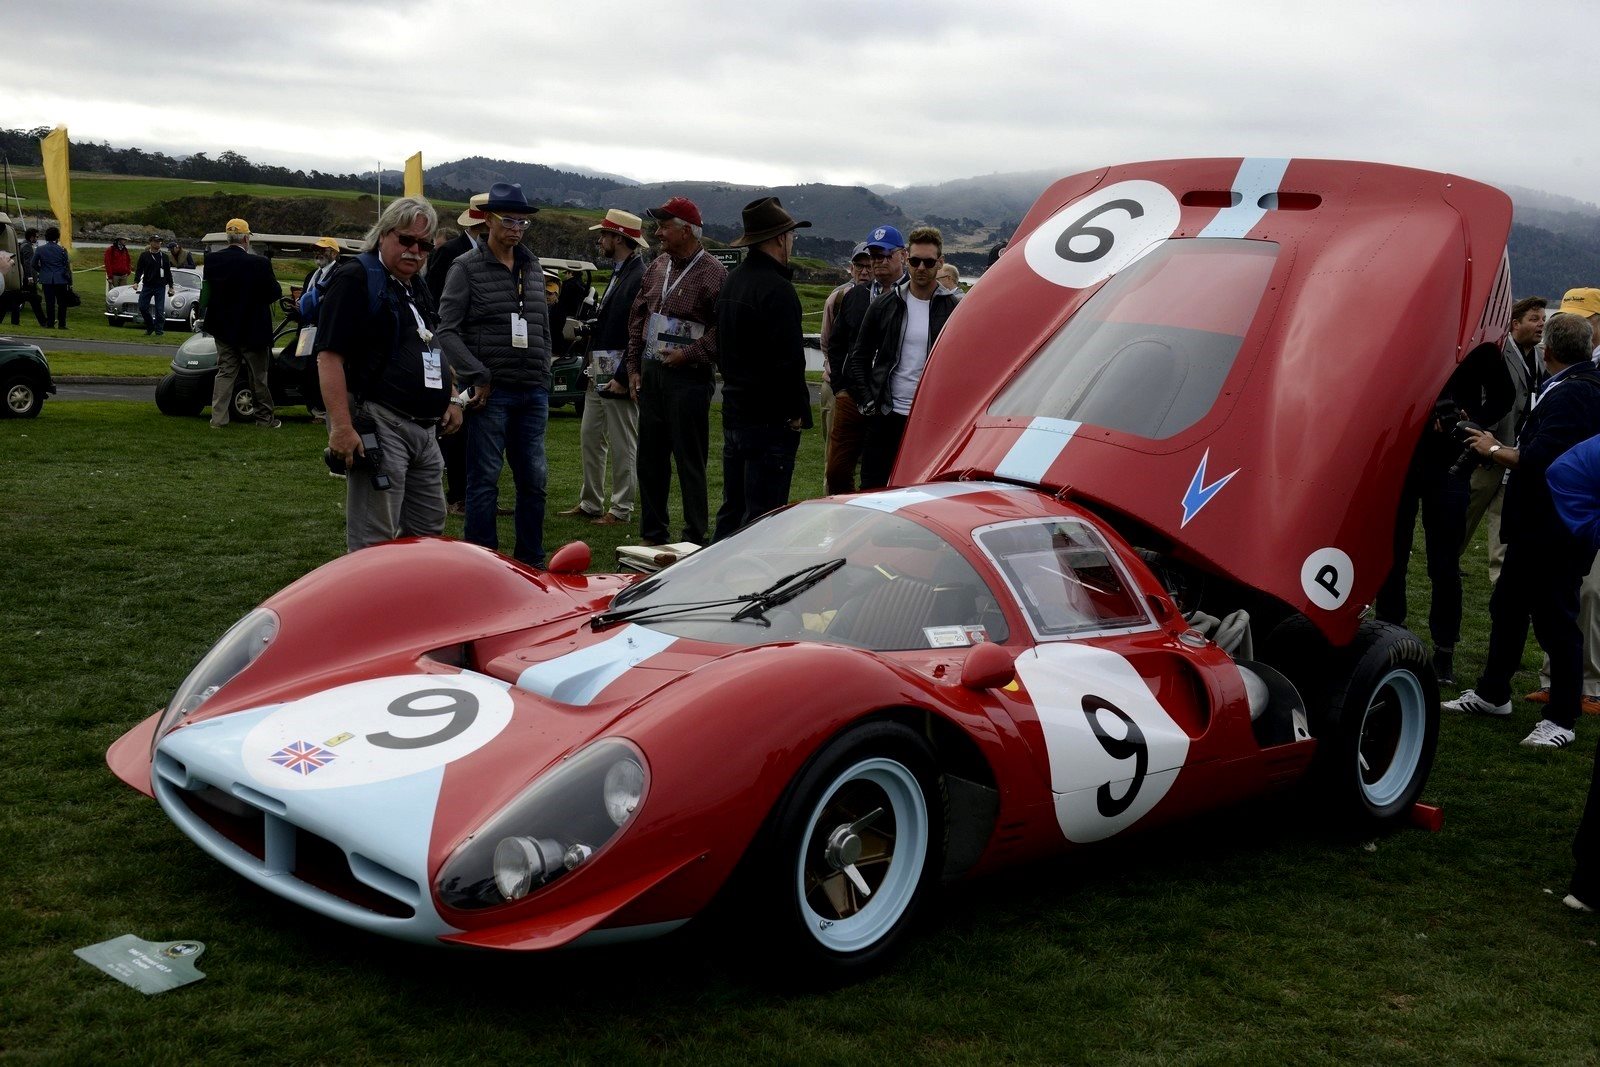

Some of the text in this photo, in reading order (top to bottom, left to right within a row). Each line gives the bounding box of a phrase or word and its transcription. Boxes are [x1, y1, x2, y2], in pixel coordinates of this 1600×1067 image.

[1314, 564, 1341, 600] P
[365, 688, 480, 750] 9
[1081, 694, 1148, 817] 9
